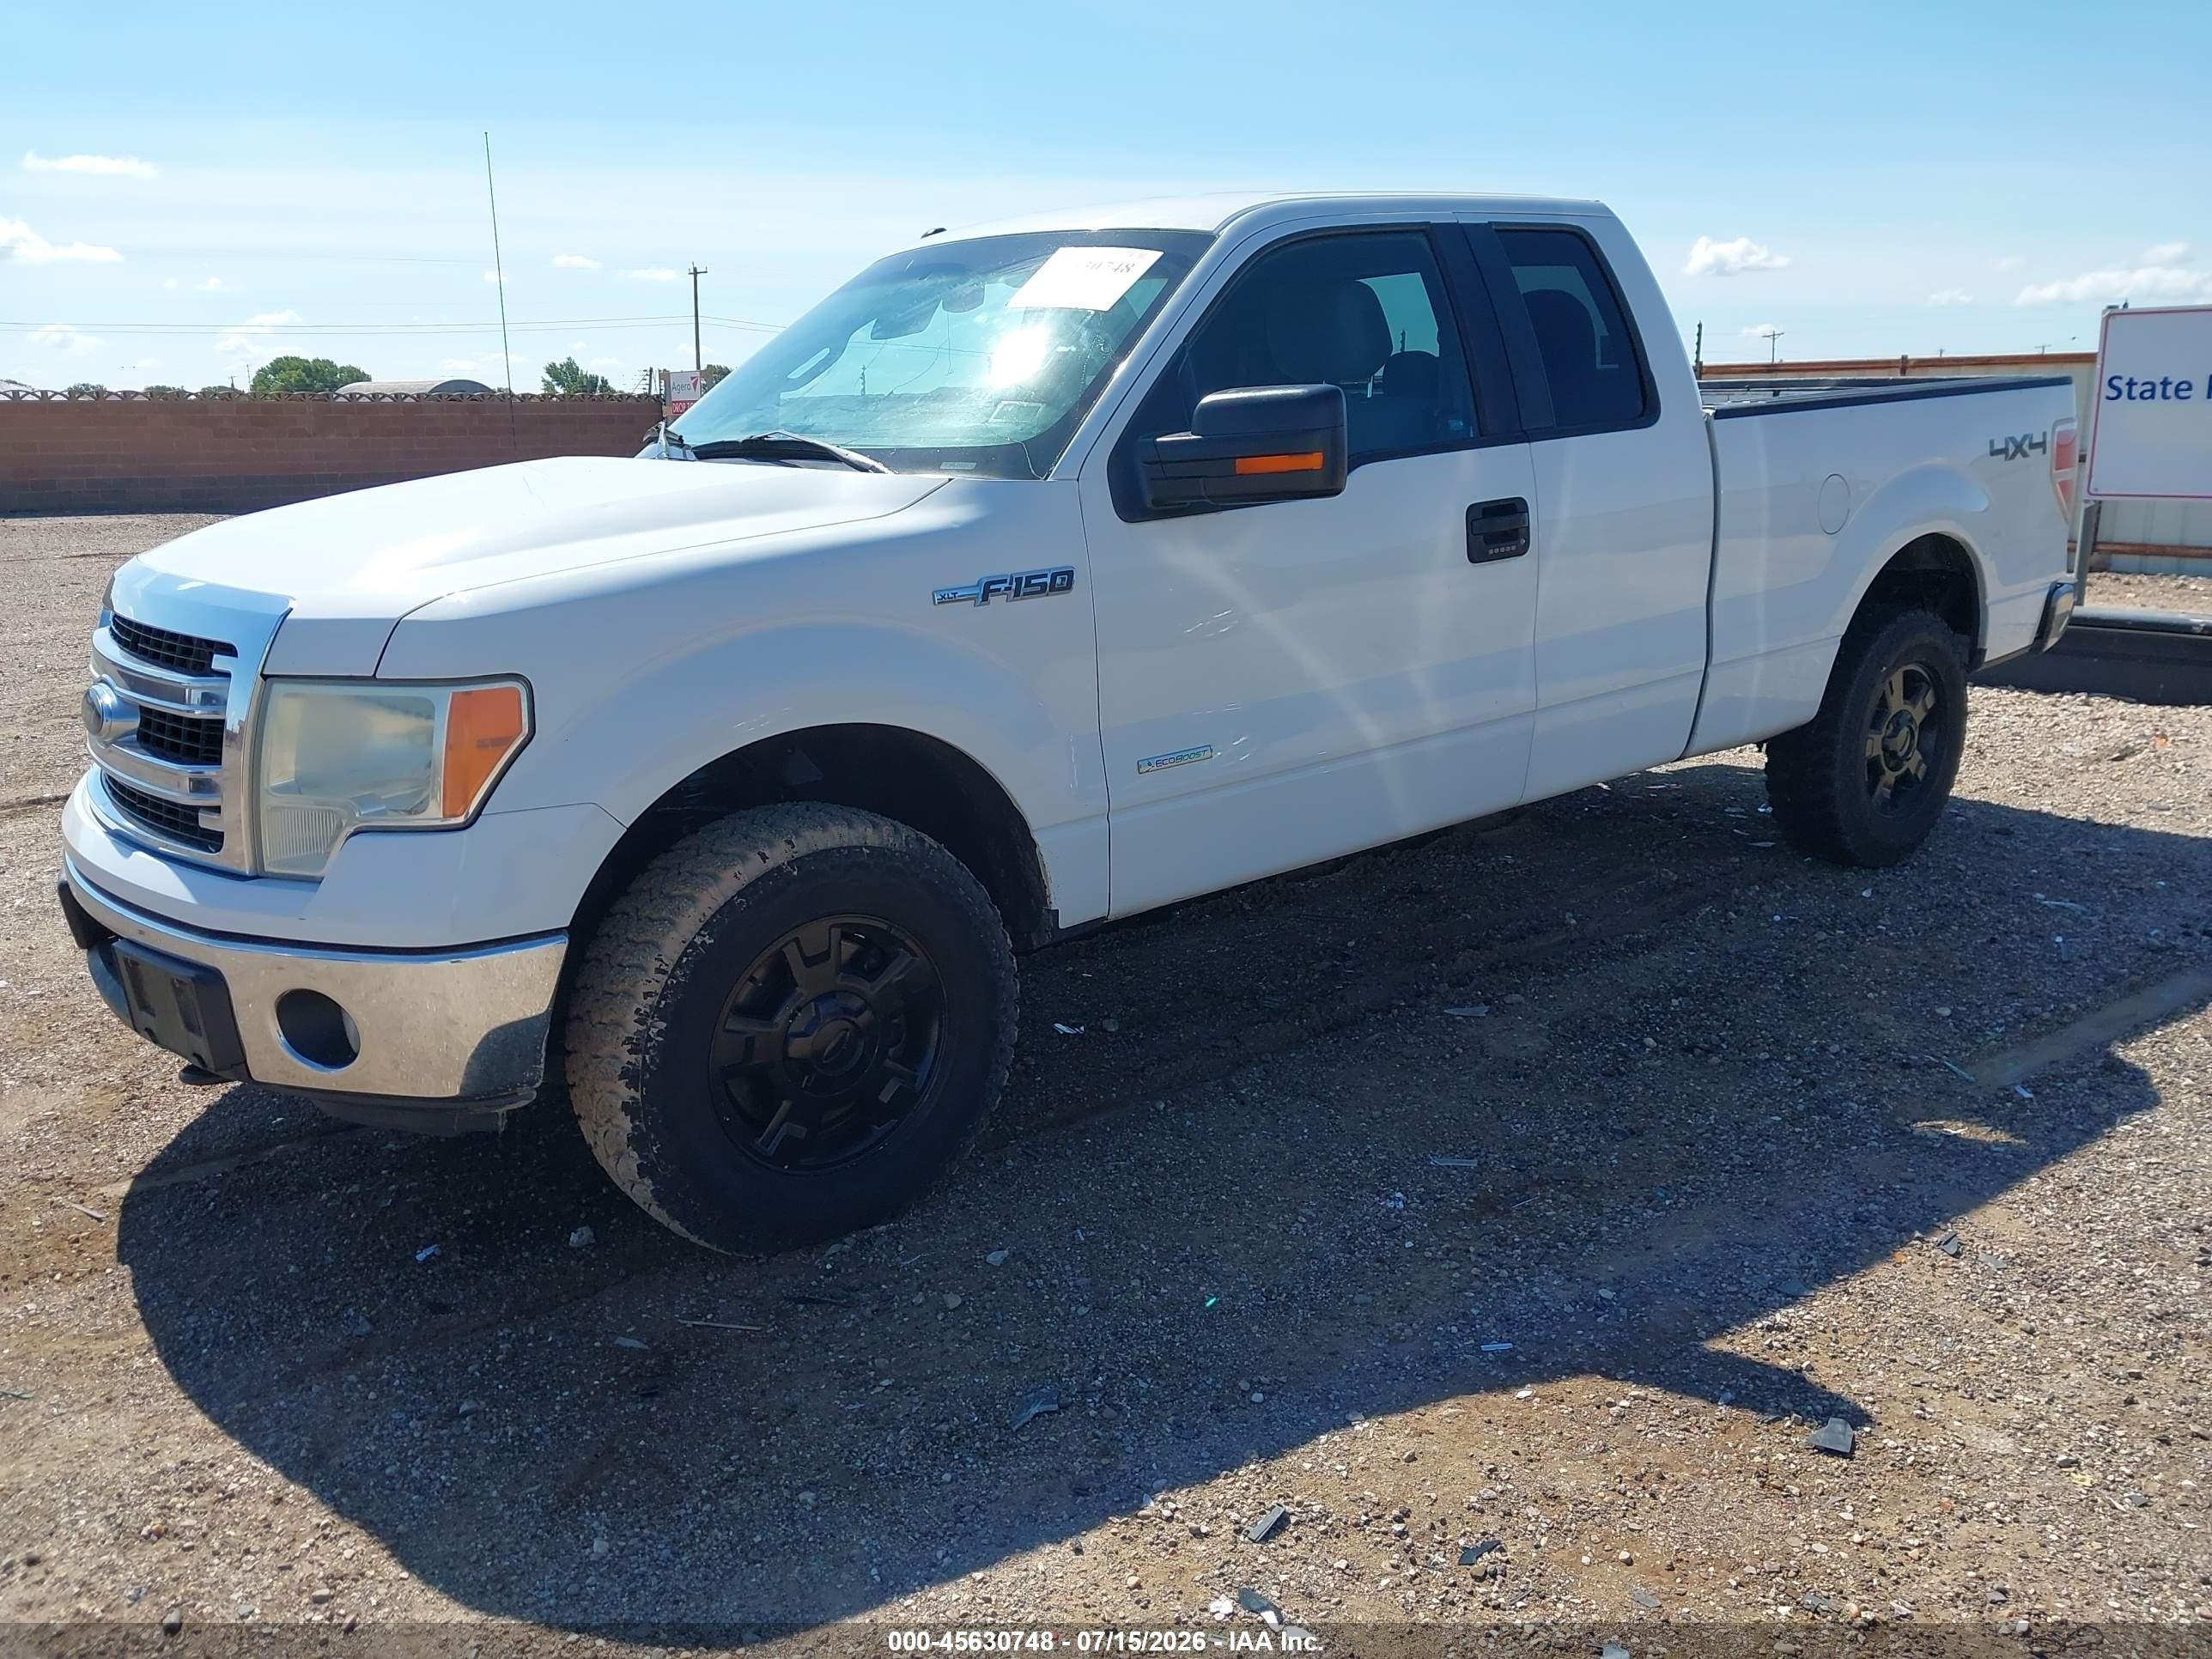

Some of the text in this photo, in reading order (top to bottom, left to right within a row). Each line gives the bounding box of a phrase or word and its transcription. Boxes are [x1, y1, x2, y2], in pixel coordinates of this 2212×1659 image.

[672, 381, 690, 394] Agero
[2105, 374, 2193, 400] State
[939, 568, 1075, 603] XLT F-150
[1155, 750, 1208, 768] ECOBOOST
